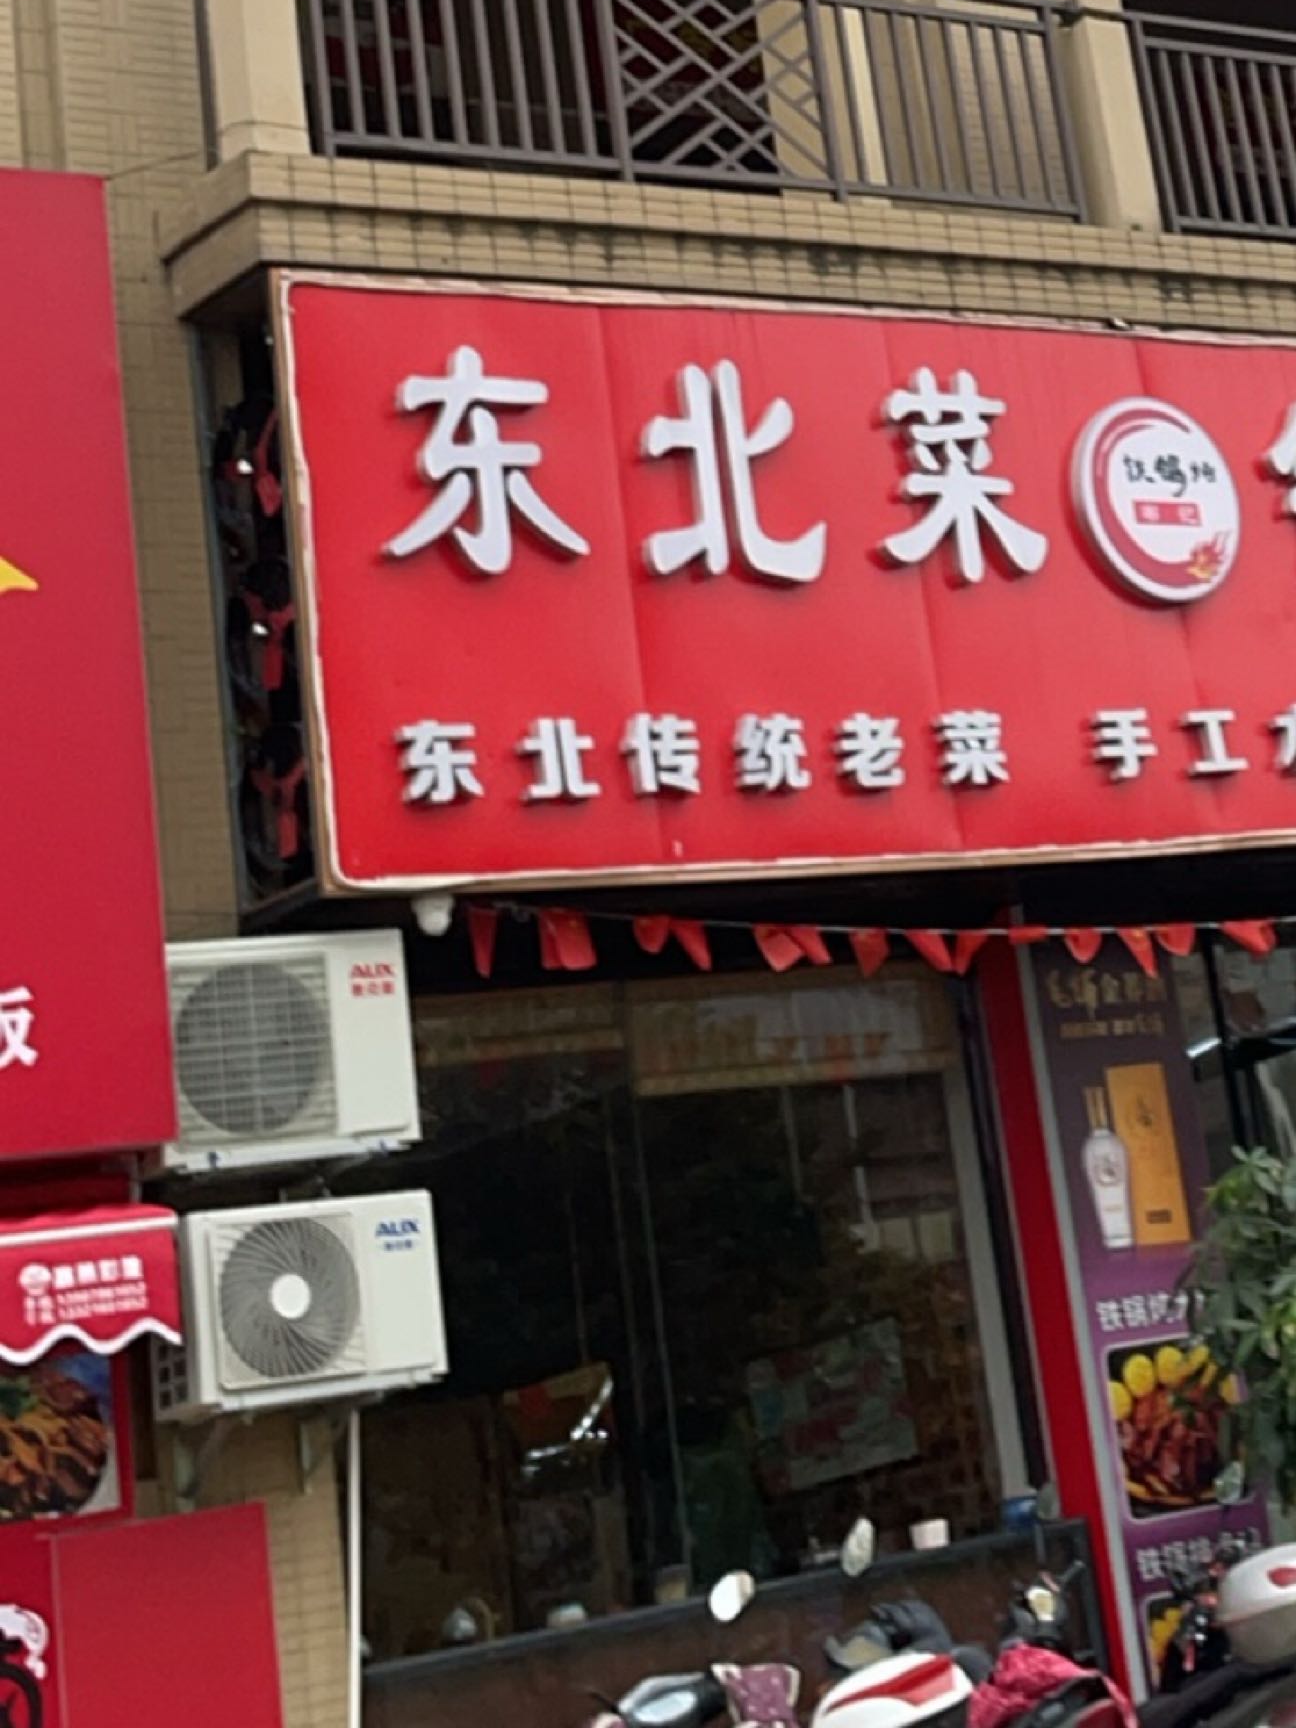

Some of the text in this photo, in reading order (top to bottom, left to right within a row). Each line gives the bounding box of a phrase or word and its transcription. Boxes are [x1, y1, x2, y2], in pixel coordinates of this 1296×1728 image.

[383, 344, 1048, 585] 东北菜
[398, 709, 1010, 802] 东北传统老菜
